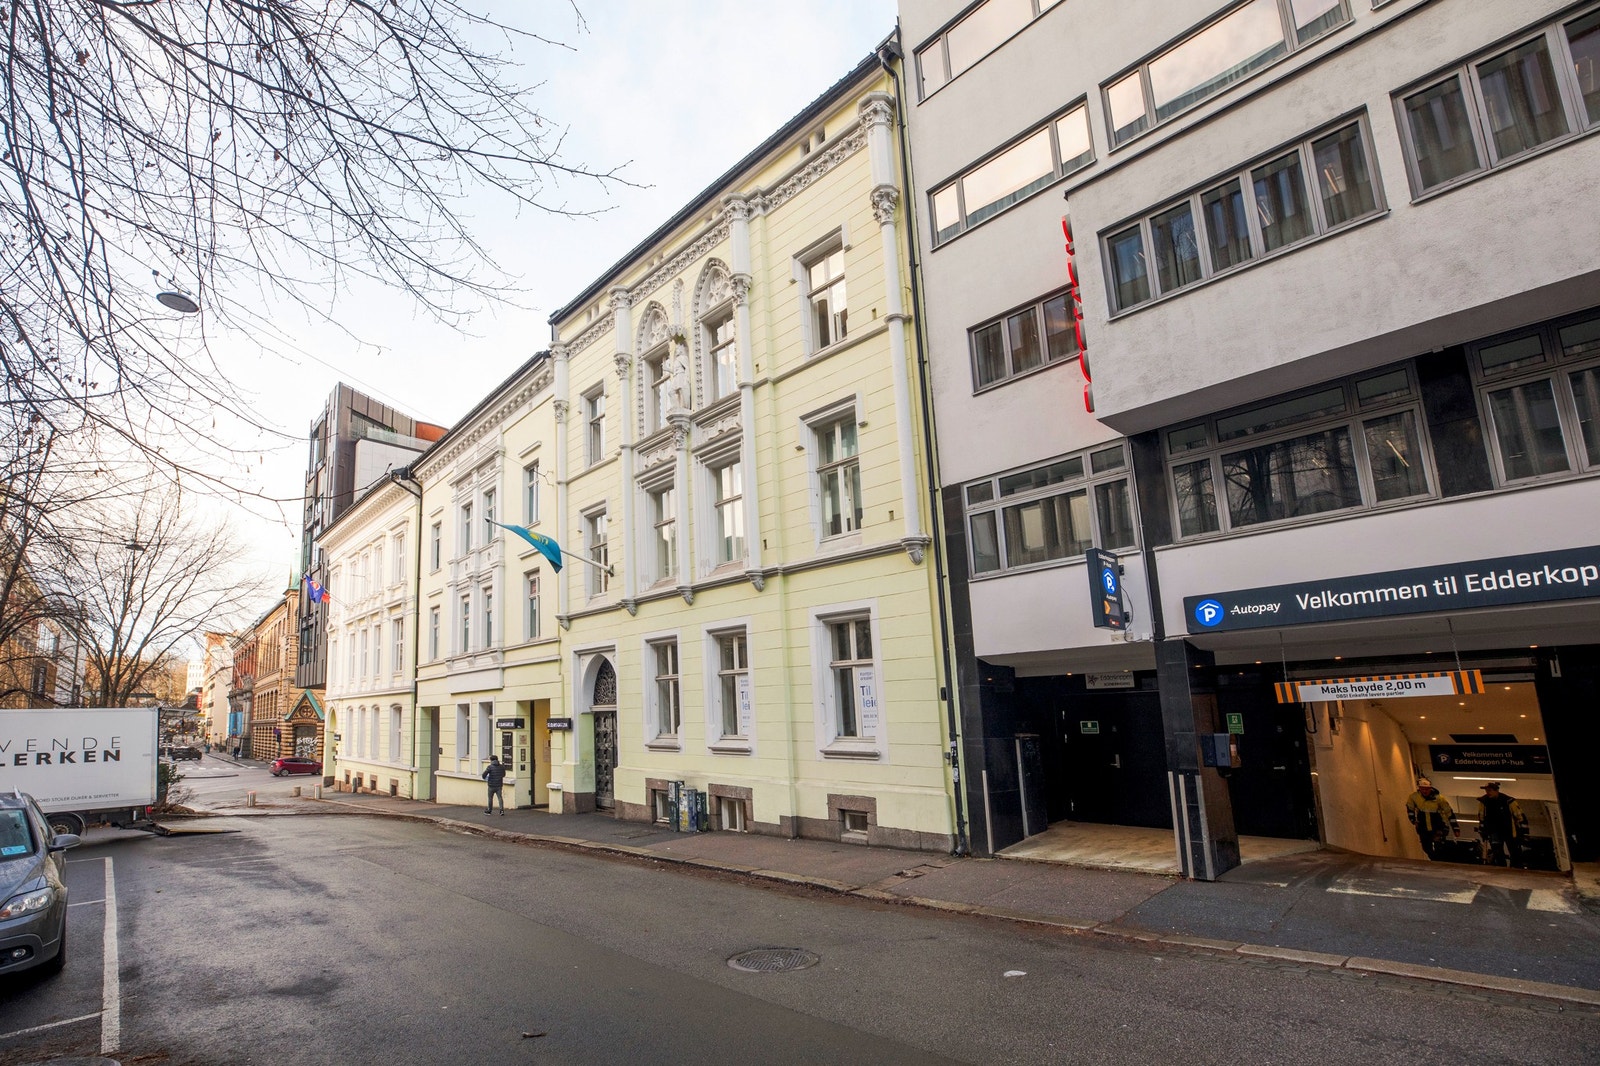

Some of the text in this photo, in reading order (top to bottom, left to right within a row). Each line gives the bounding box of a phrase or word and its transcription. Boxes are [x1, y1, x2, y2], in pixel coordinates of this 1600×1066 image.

[1296, 563, 1600, 610] Velkommen til Edderkop
[1230, 602, 1281, 616] Autopay
[860, 685, 871, 696] Til
[1321, 684, 1349, 694] Maks
[1350, 682, 1383, 694] høyde
[1385, 680, 1412, 691] 2,00
